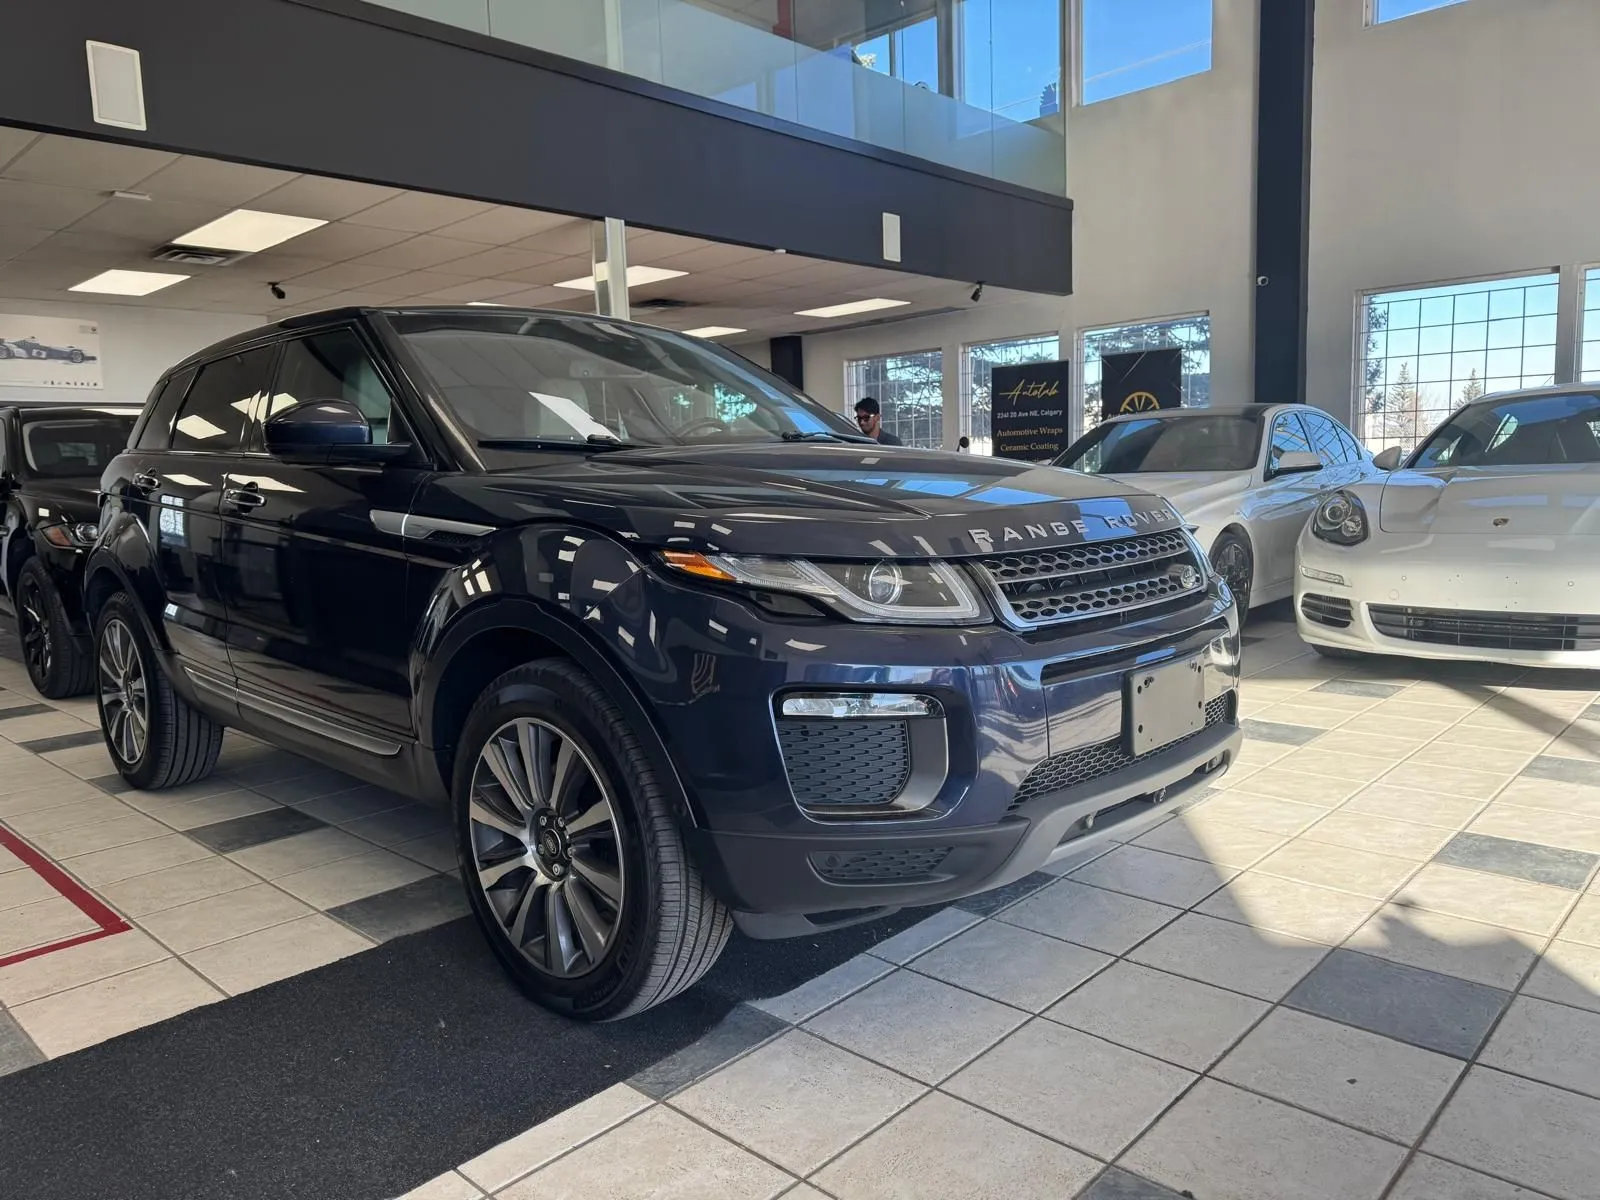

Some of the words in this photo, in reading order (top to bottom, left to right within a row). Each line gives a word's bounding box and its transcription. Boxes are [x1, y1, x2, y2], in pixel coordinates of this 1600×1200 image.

[996, 428, 1039, 437] Automotive
[1039, 425, 1063, 436] Wraps
[1000, 443, 1029, 451] Ceramic
[1030, 441, 1059, 452] Coating
[967, 519, 1090, 545] RANGE
[1103, 507, 1176, 529] ROVER
